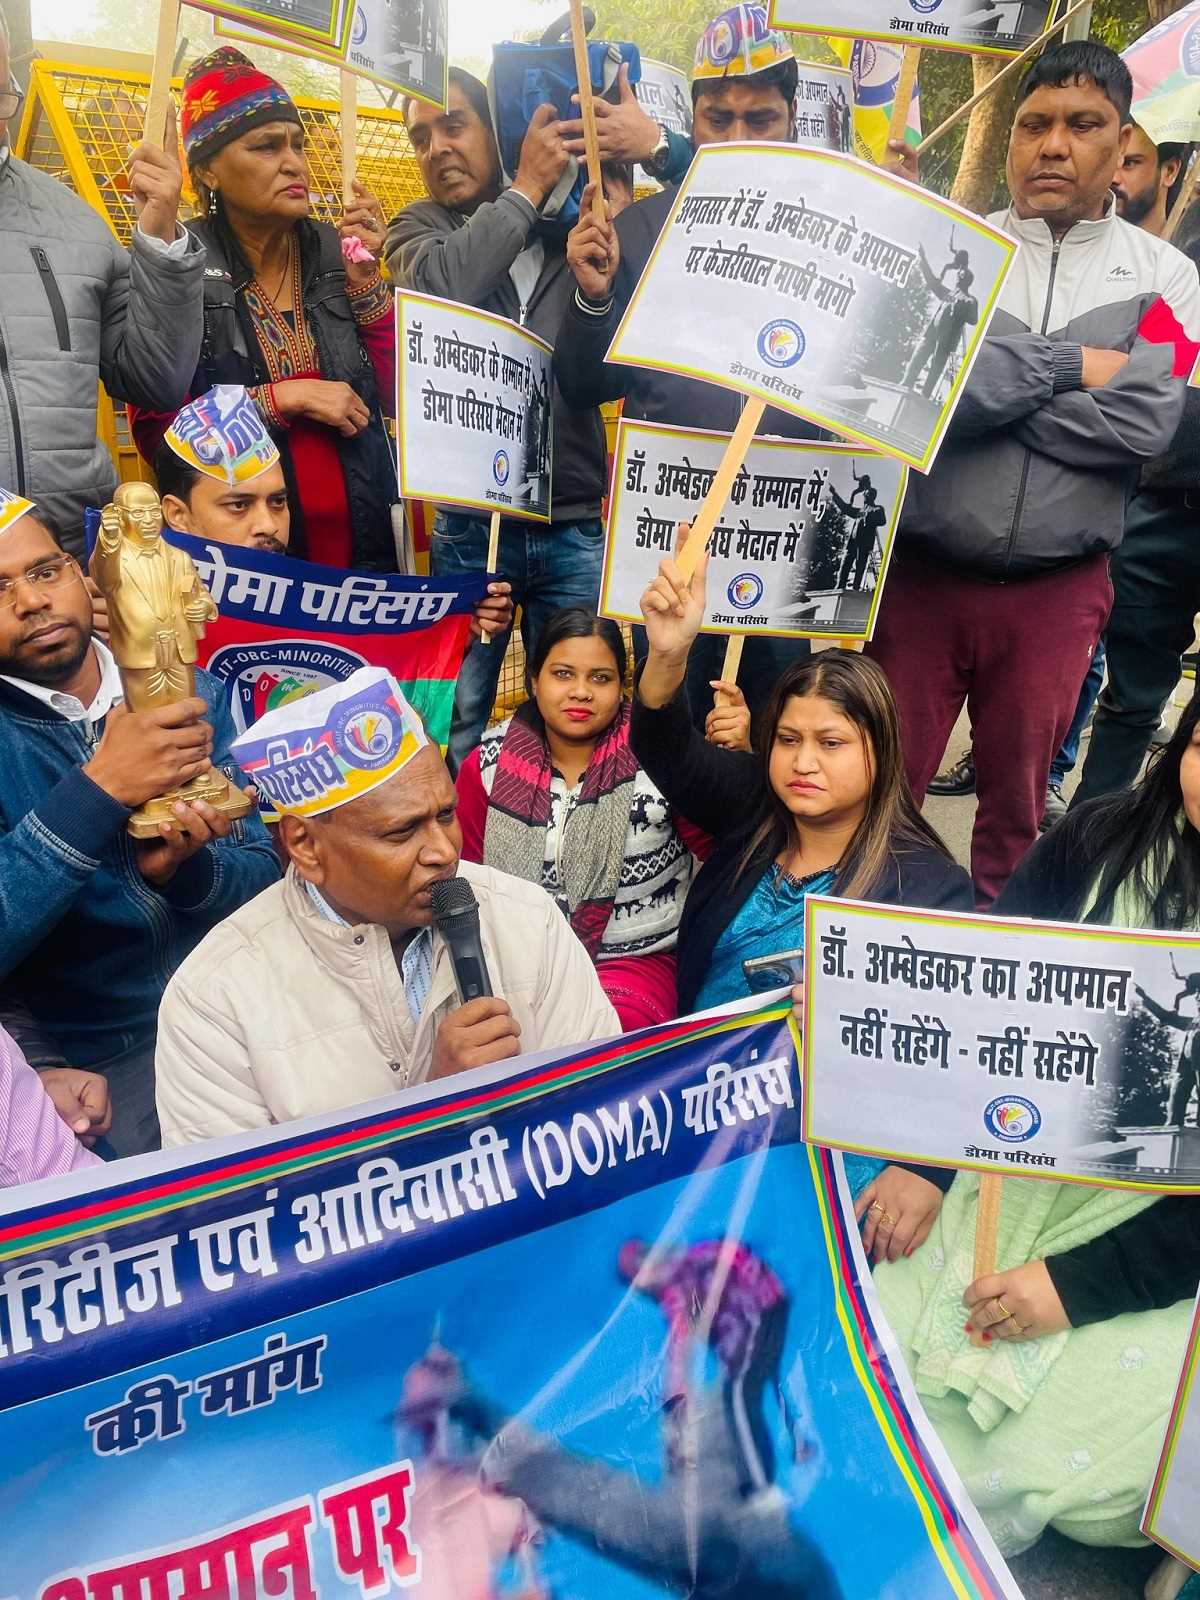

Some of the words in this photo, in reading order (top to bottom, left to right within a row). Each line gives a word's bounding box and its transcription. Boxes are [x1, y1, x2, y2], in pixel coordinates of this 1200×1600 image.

[889, 17, 914, 31] डोमा
[916, 20, 950, 36] परिसंघ
[805, 80, 828, 104] अपमान
[675, 196, 732, 233] अमृतसर
[727, 188, 752, 226] में
[740, 189, 768, 229] डॉ.
[765, 198, 838, 252] अम्बेडकर
[835, 215, 858, 253] के
[852, 232, 916, 285] अपमान
[685, 246, 708, 273] पर
[702, 240, 778, 287] केजरीवाल
[407, 320, 428, 365] डॉ.
[433, 329, 487, 379] अम्बेडकर
[488, 341, 500, 382] के
[501, 354, 524, 393] सम्मान
[729, 360, 760, 381] डोमा
[761, 375, 805, 400] परिसंघ
[422, 379, 453, 425] डोमा
[456, 388, 494, 434] परिसंघ
[496, 395, 515, 441] मैदान
[516, 405, 526, 444] में
[626, 451, 648, 494] डॉ.
[654, 456, 718, 501] अम्बेडक
[731, 463, 751, 505] के
[752, 475, 806, 511] सम्मान
[636, 508, 675, 552] डोमा
[736, 519, 782, 562] मैदान
[783, 522, 804, 563] में
[300, 576, 459, 626] परिसंघ
[711, 613, 735, 625] डोमा
[736, 614, 769, 625] परिसंघ
[253, 740, 345, 807] परिसंघ
[820, 926, 854, 979] डॉ.
[865, 936, 976, 996] अम्बेडकर
[980, 957, 1020, 1001] का
[1026, 961, 1132, 1012] अपमान
[840, 1008, 888, 1060] नहीं
[891, 1014, 952, 1070] सहेंगे
[977, 1027, 1031, 1079] नहीं
[1033, 1031, 1099, 1087] सहेंगे
[964, 1144, 1000, 1161] डोमा
[1003, 1151, 1057, 1167] परिसंघ
[0, 1243, 181, 1357] रिटीज
[189, 1187, 278, 1292] एवं
[292, 1126, 516, 1264] आदिवासी
[523, 1090, 673, 1200] (DOMA)
[682, 1049, 797, 1136] परिसंघ
[87, 1377, 191, 1455] की
[201, 1335, 326, 1415] मांग
[322, 1468, 418, 1591] पर
